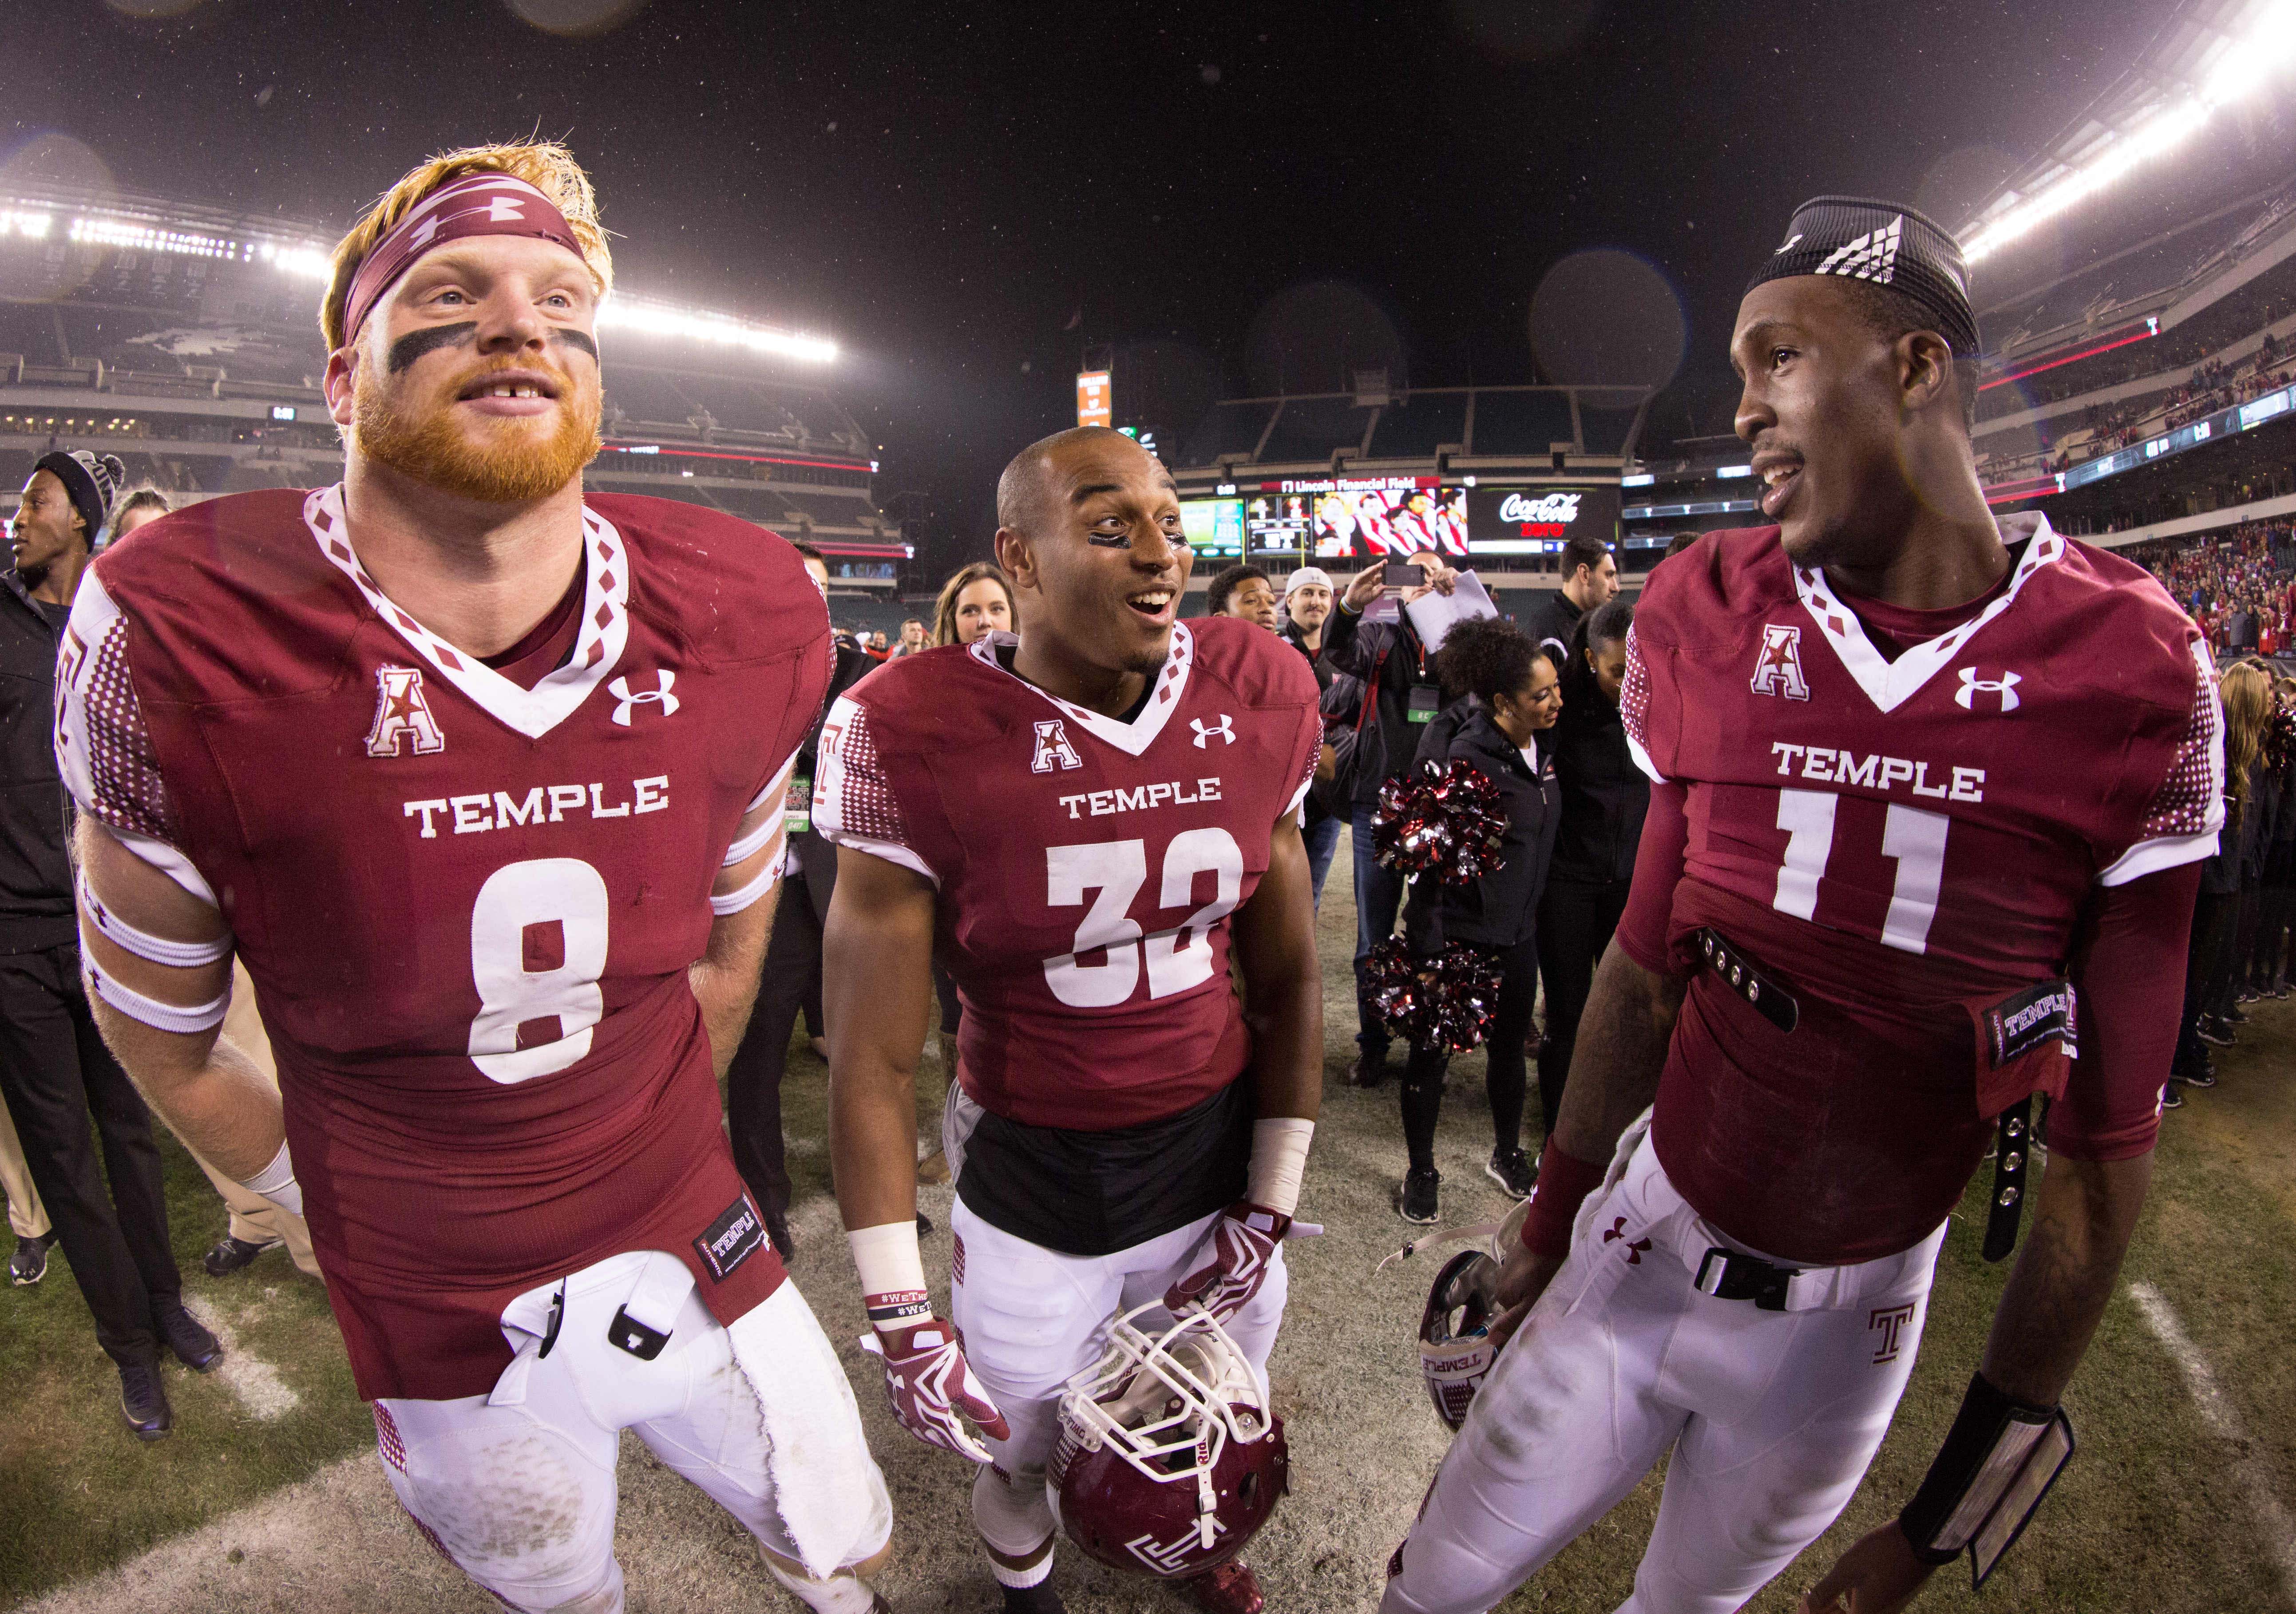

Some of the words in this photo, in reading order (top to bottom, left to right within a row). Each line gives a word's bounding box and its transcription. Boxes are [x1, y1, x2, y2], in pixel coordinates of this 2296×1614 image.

[1296, 479, 1335, 492] Lincoln
[1337, 478, 1386, 491] Financial
[1388, 476, 1416, 489] Field
[1771, 741, 1985, 802] TEMPLE
[404, 774, 669, 838] TEMPLE
[1059, 777, 1221, 820] TEMPLE
[1773, 787, 1950, 955] 11
[1042, 827, 1243, 1007] 32
[467, 857, 609, 1085] 8
[2004, 993, 2067, 1037] TEMPLE
[711, 1211, 755, 1258] TEMPLE
[701, 1243, 723, 1277] AUTHENTIC
[1868, 1302, 1916, 1364] T
[1423, 1353, 1482, 1373] TEMPLE
[1066, 1416, 1086, 1440] OWLS
